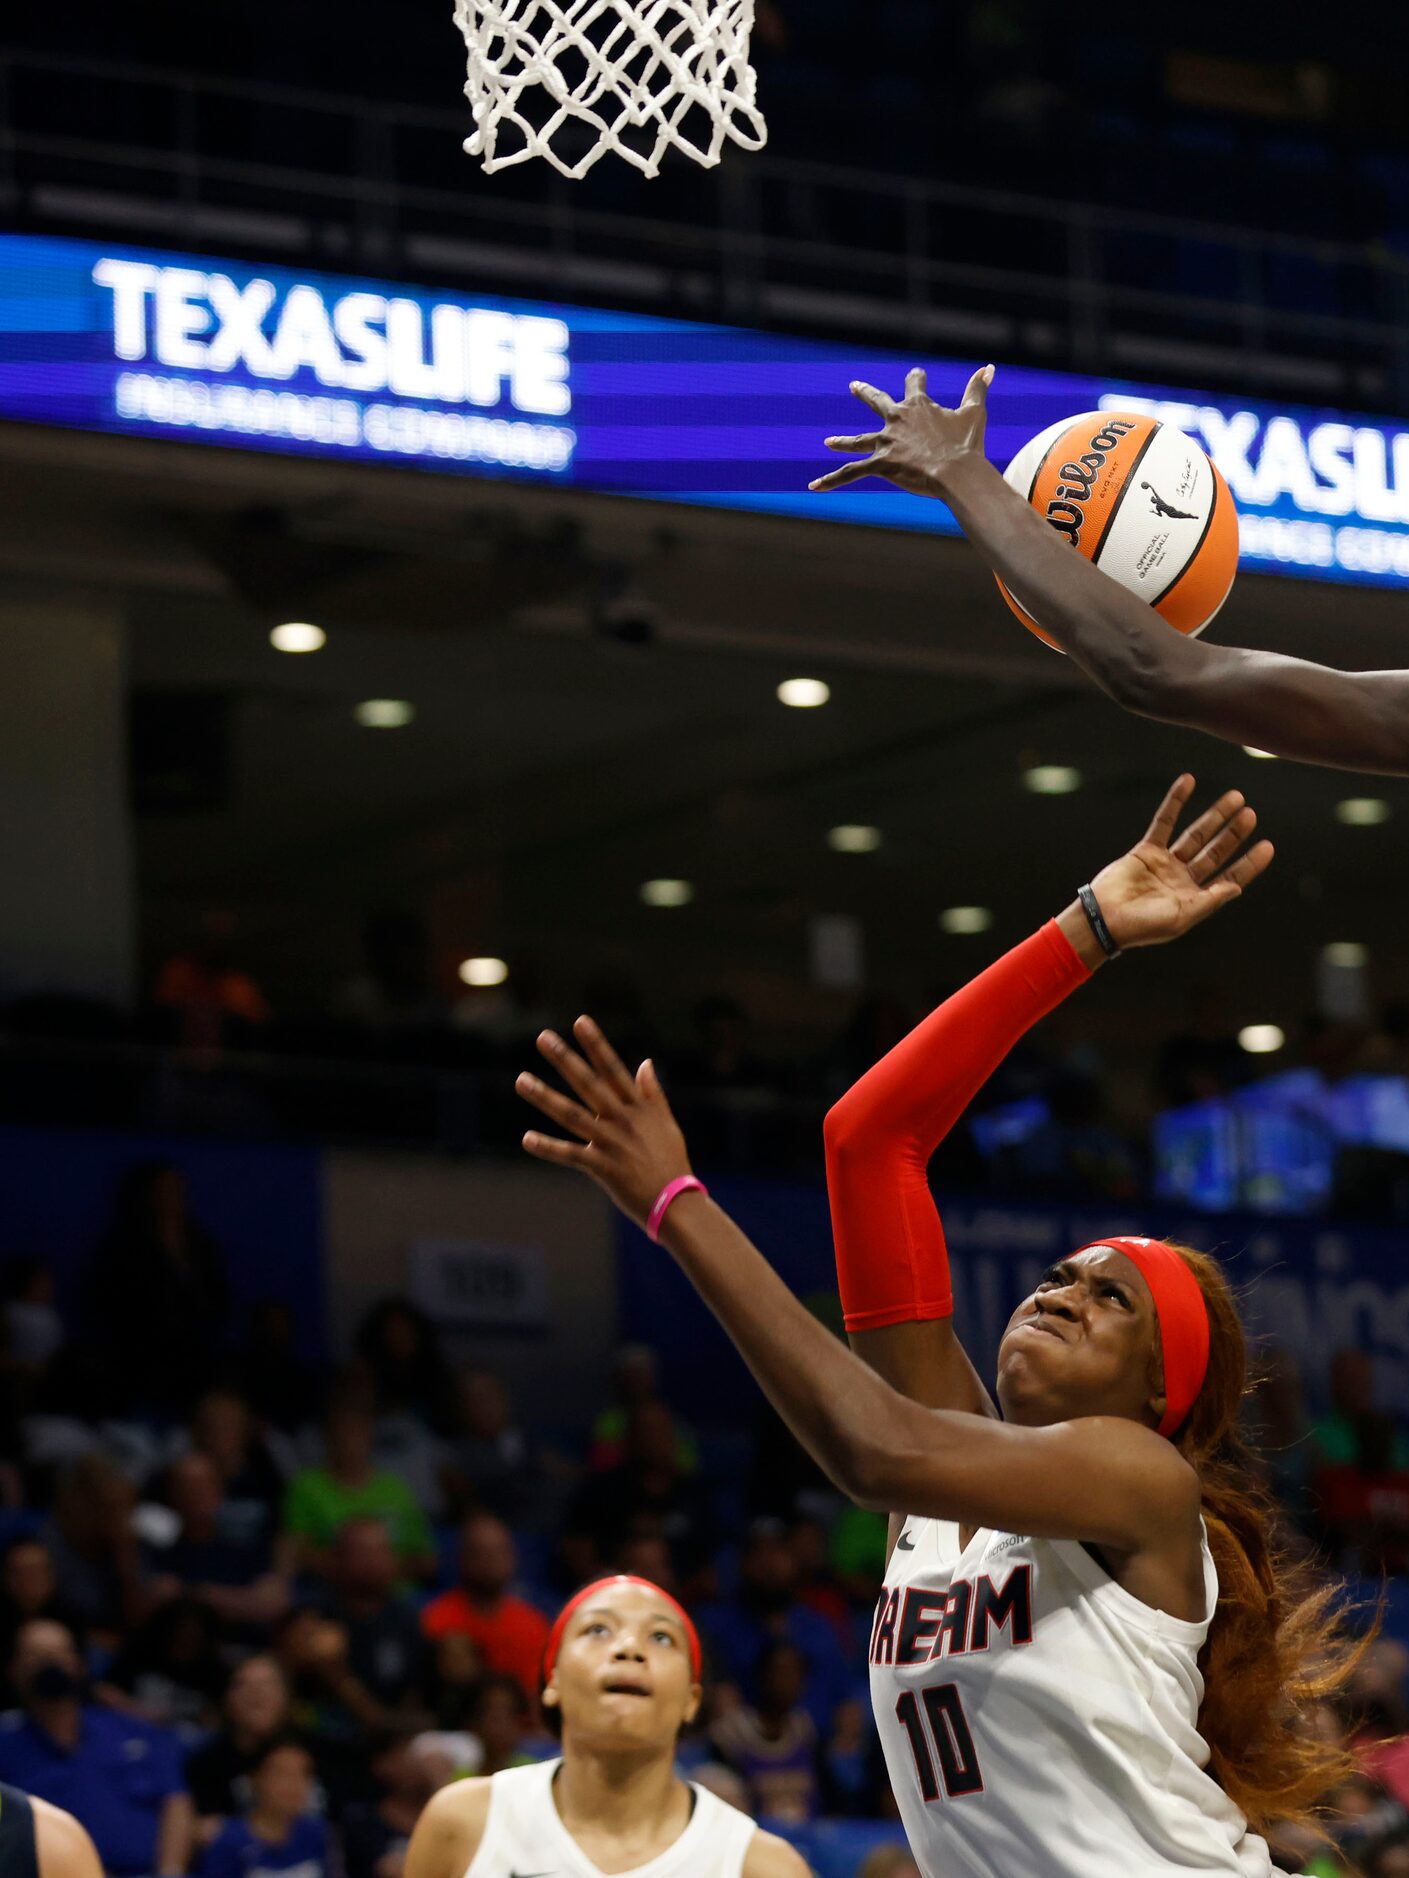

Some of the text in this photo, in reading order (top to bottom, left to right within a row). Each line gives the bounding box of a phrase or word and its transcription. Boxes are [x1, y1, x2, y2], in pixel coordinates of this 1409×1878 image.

[1045, 420, 1136, 548] Wilson
[1136, 533, 1161, 571] OFFICIAL
[895, 1682, 985, 1802] 10
